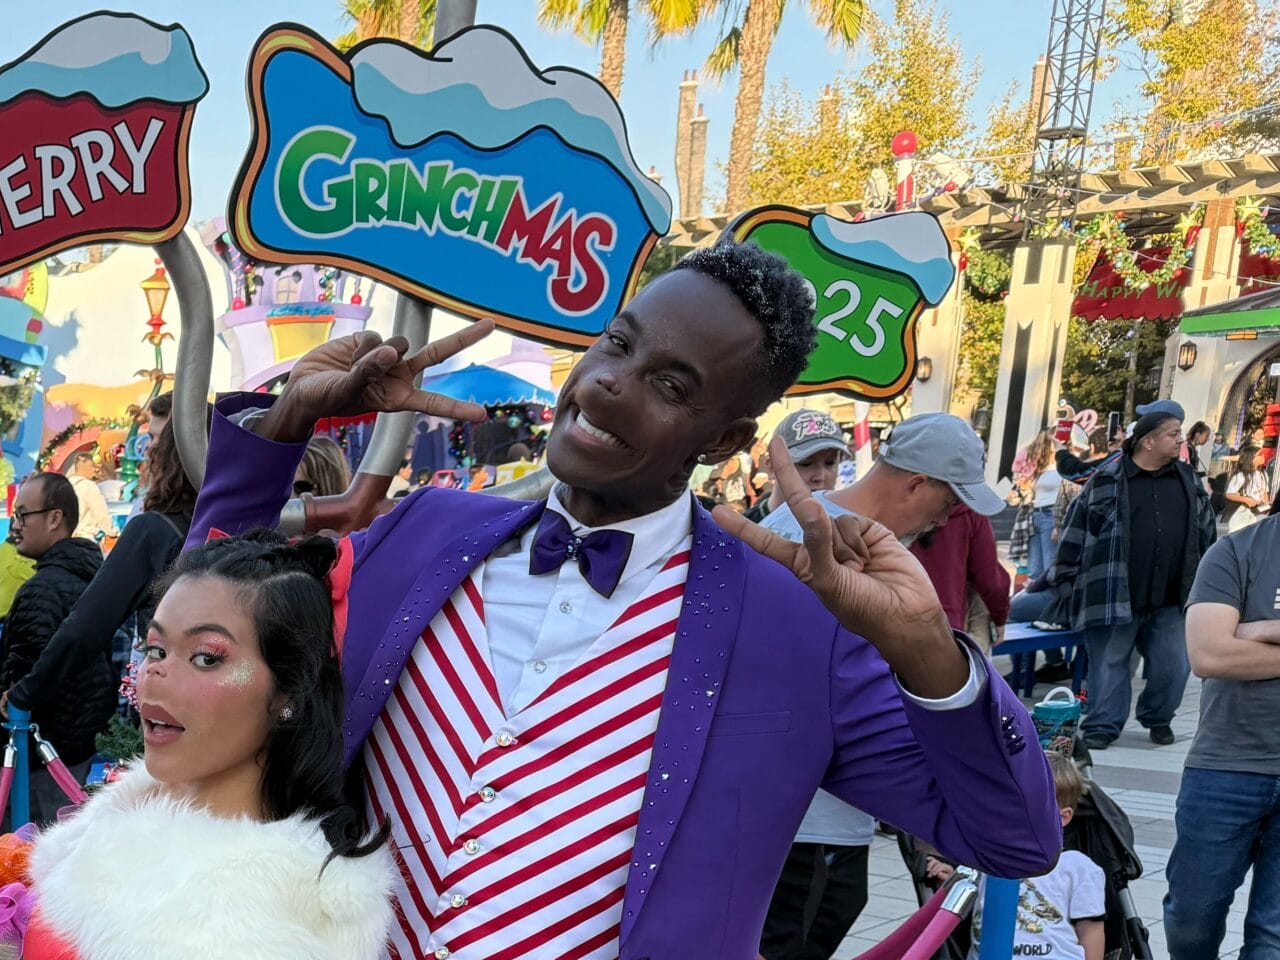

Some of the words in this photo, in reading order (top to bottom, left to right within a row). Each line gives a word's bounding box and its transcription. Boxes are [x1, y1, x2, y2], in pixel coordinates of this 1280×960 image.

[274, 125, 618, 316] GRINCHMAS
[803, 278, 905, 357] 25
[1013, 943, 1052, 956] WORLD
